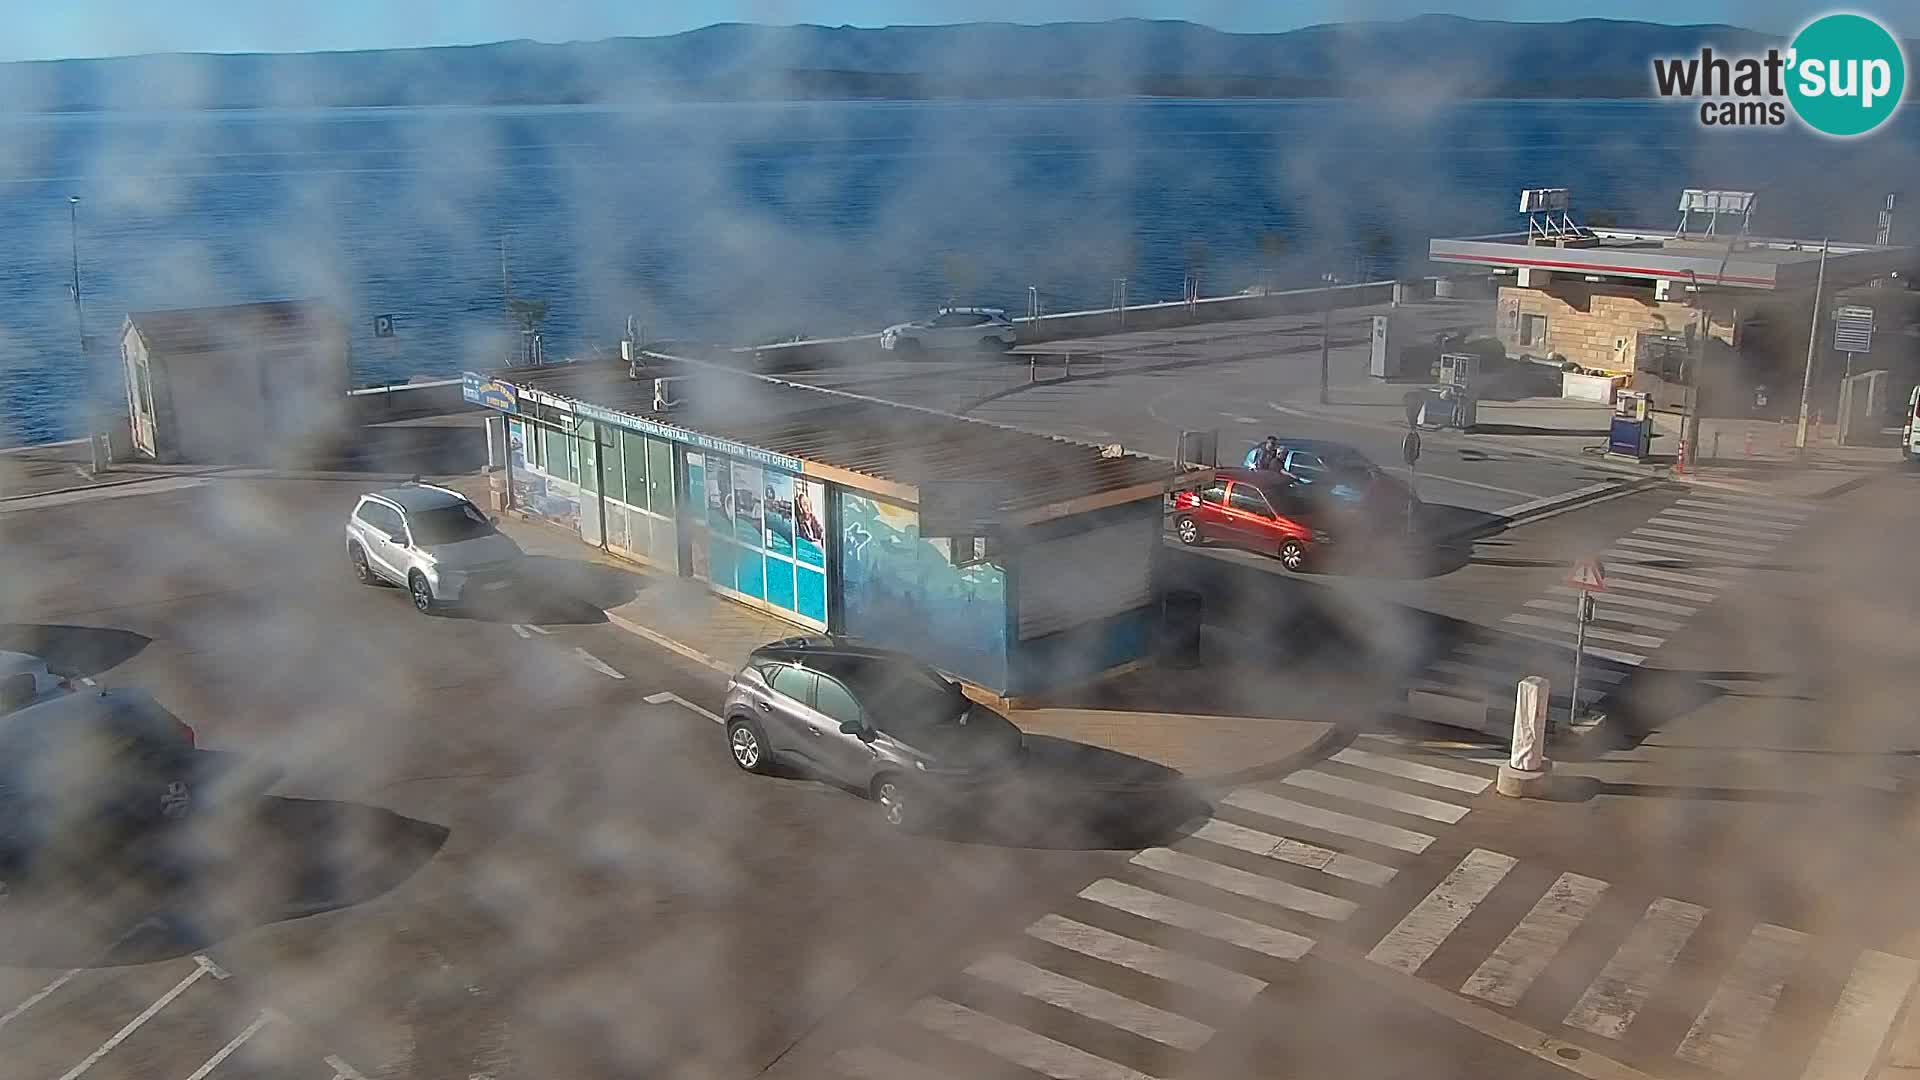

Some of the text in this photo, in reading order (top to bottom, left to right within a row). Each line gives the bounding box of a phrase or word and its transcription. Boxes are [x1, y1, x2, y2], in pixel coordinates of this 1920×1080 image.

[621, 416, 658, 434] AUTOBUSNA
[660, 427, 689, 441] POSTAJA
[699, 436, 712, 448] BUS
[713, 440, 744, 455] STATION
[747, 448, 770, 465] TICKET
[772, 456, 798, 470] OFFICE
